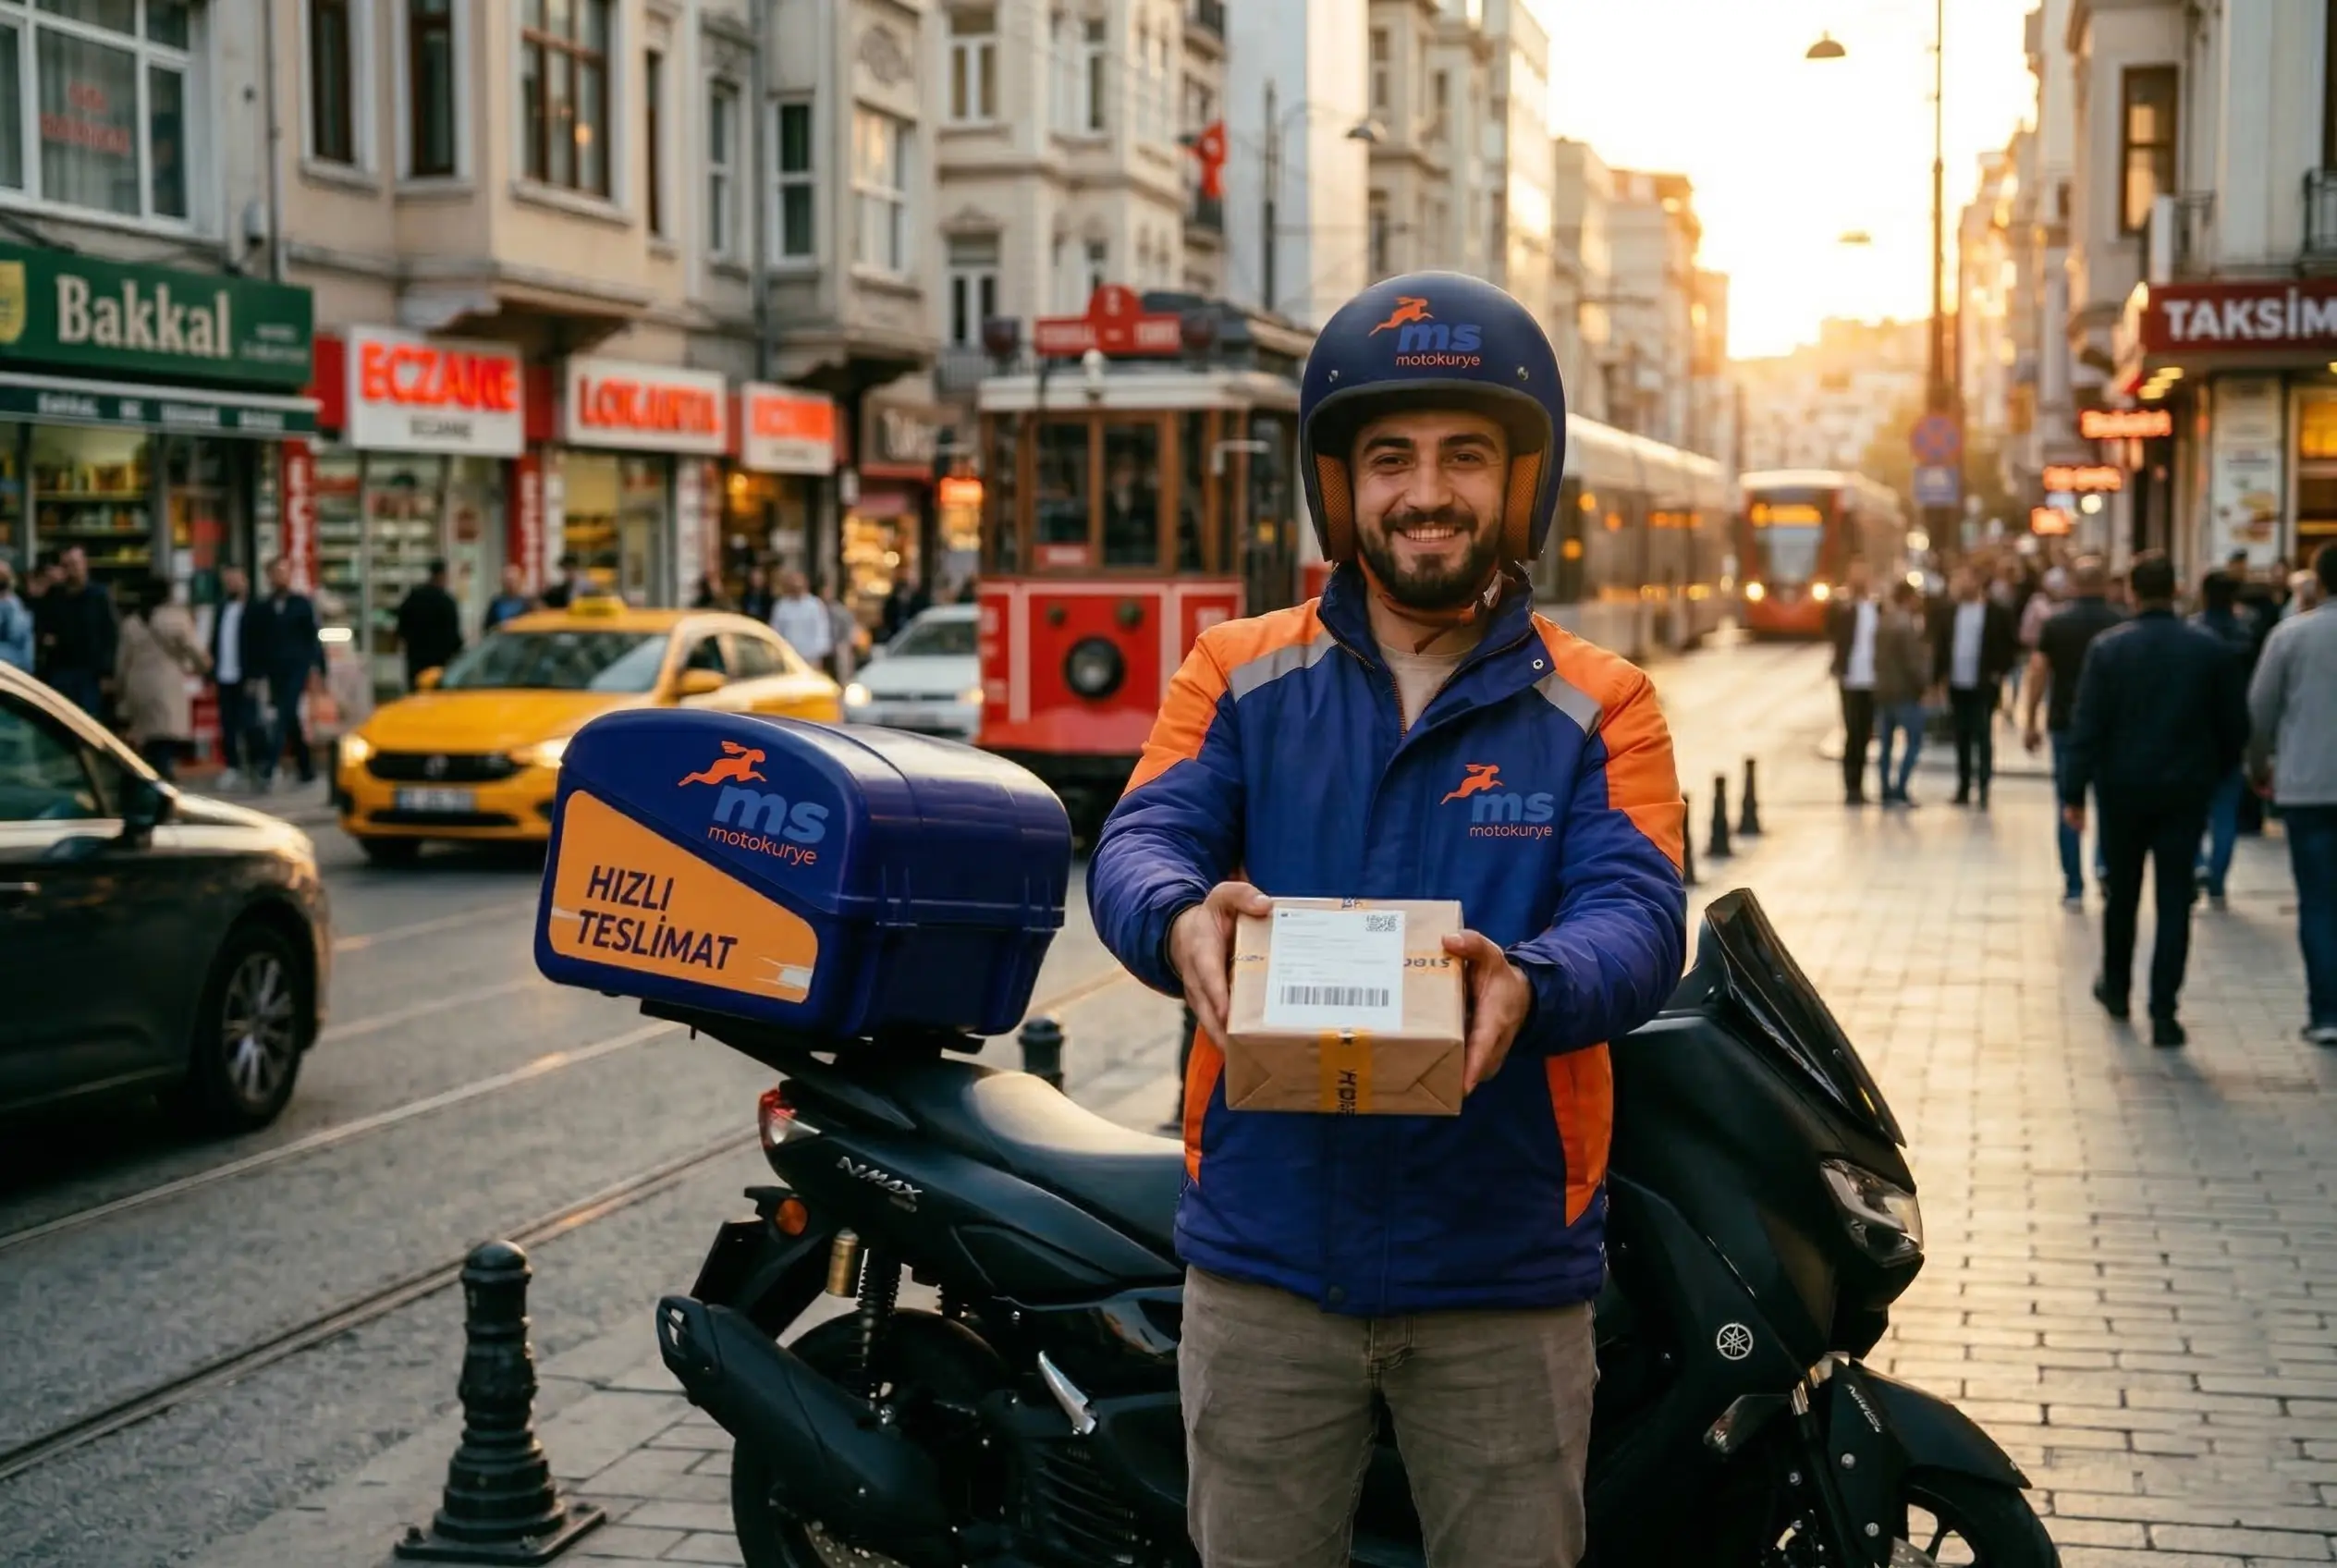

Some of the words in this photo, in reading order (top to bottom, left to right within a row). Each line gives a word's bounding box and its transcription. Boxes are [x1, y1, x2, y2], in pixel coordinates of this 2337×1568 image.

[55, 274, 230, 359] Bakkal
[2161, 286, 2337, 341] TAKSİM
[1396, 352, 1481, 369] motokurye
[1397, 324, 1482, 352] ms
[359, 340, 520, 413] ECZANE
[713, 785, 829, 844] ms
[1469, 823, 1553, 840] motokurye
[1472, 792, 1554, 823] ms
[708, 826, 817, 865] motokurye
[586, 864, 675, 912] HIZLI
[577, 909, 739, 971] TESLİMAT
